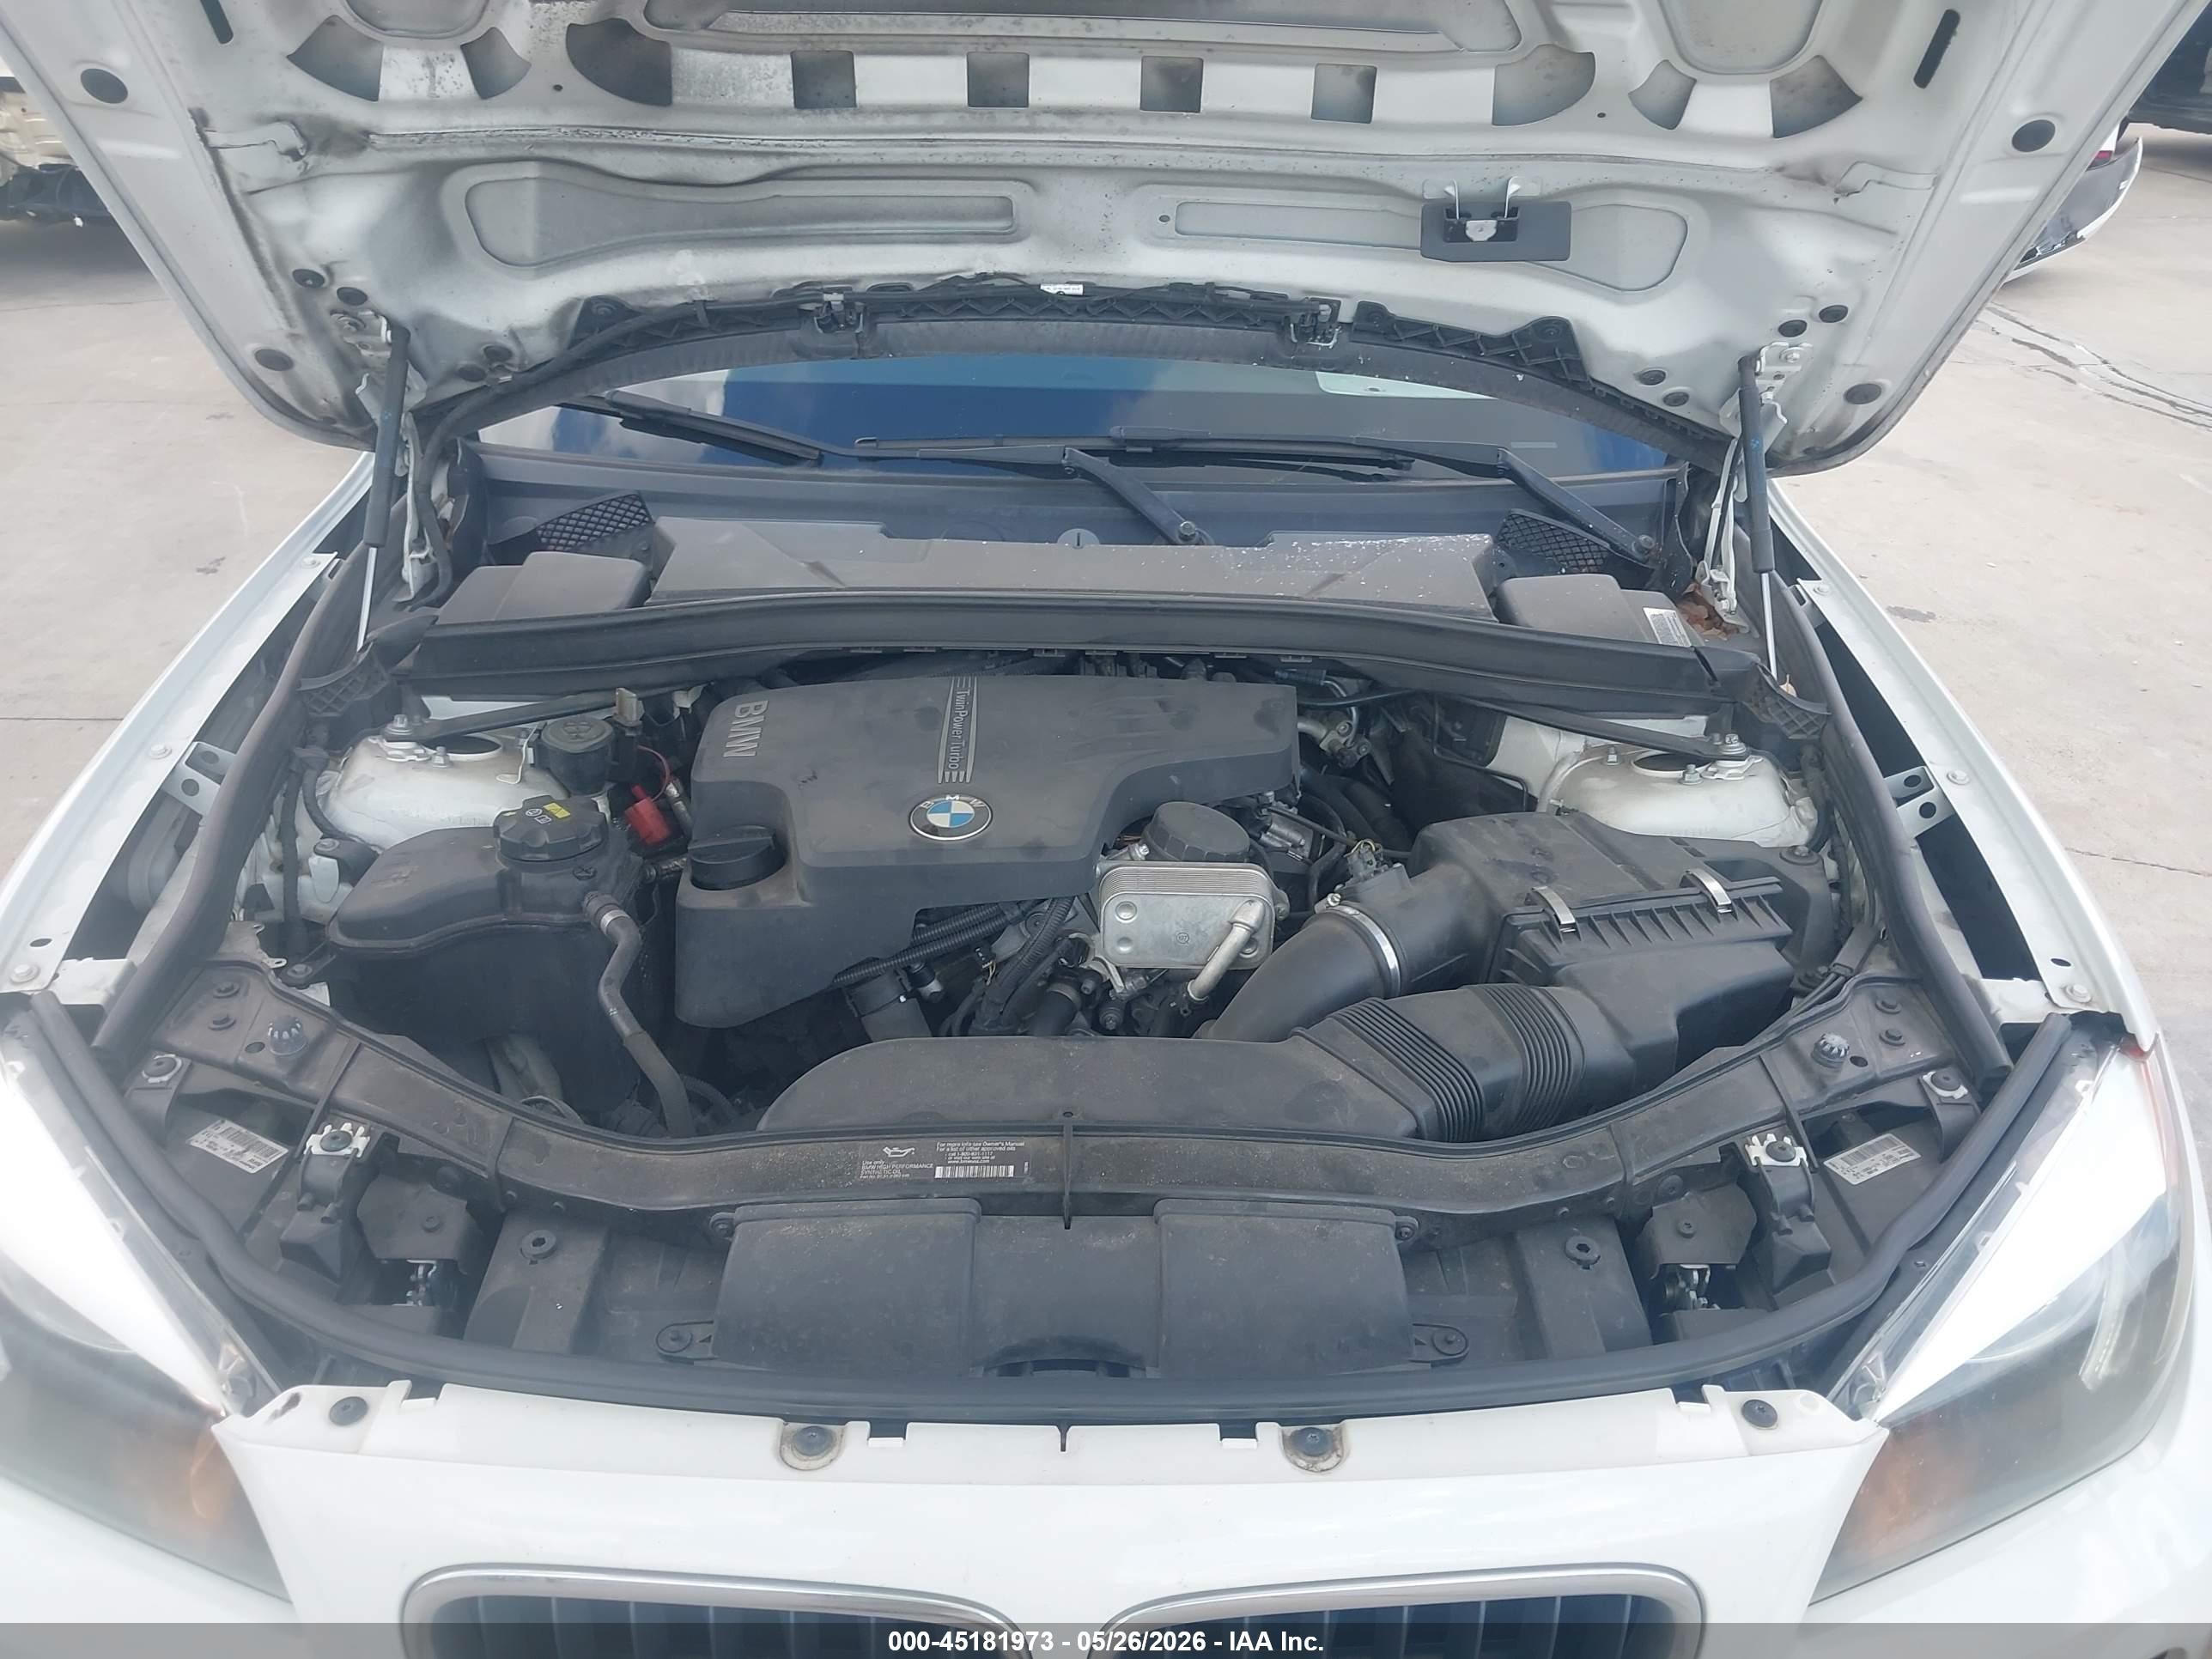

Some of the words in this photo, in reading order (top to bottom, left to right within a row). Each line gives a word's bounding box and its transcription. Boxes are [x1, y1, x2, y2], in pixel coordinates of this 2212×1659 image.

[723, 700, 769, 757] BMW
[951, 689, 970, 738] TwinPower
[948, 740, 965, 769] Turbo
[920, 794, 986, 809] BMW
